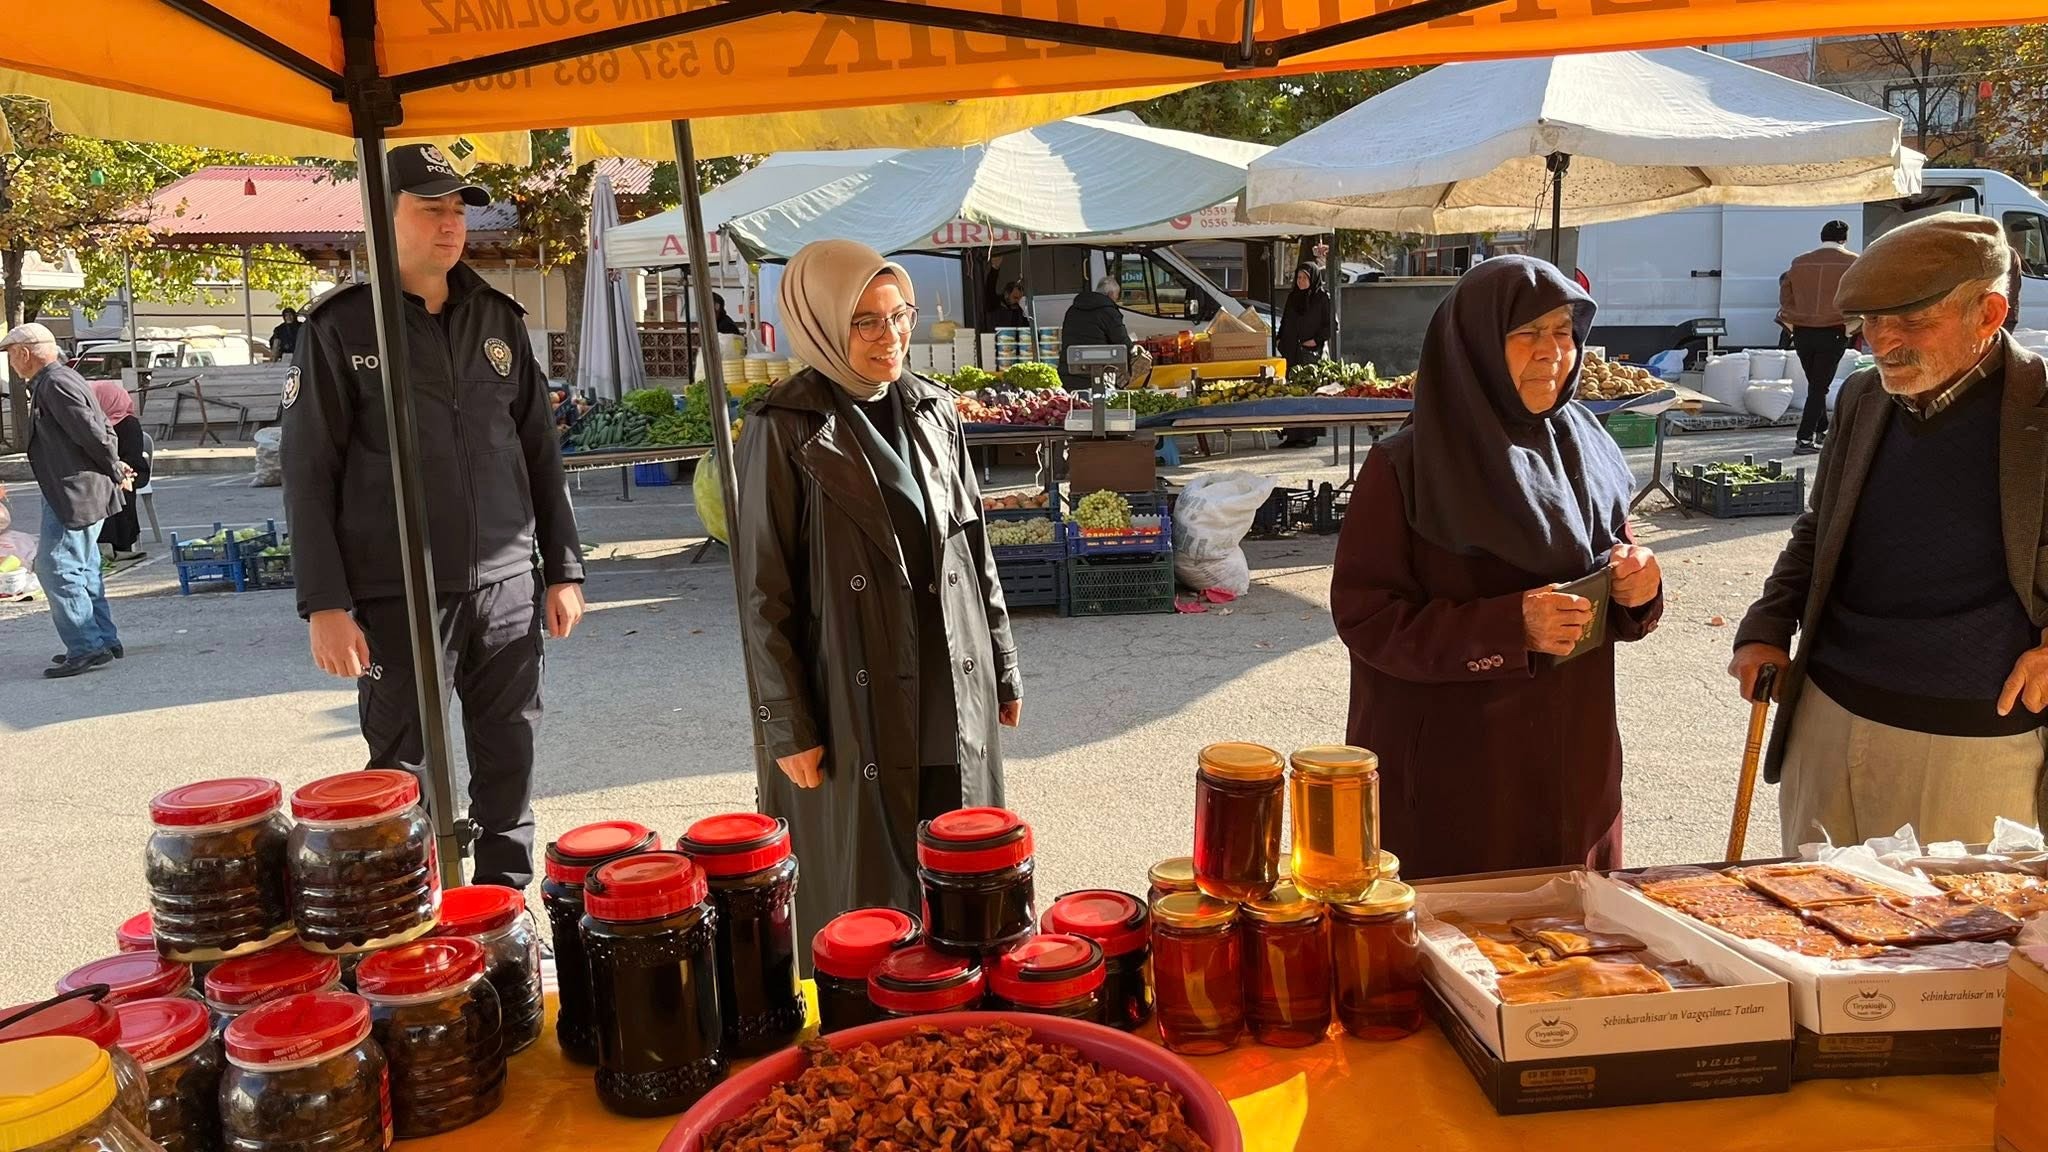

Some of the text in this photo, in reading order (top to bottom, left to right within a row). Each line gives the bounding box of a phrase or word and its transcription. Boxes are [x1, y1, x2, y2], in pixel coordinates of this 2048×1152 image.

[1602, 1003, 1764, 1028] Şebinkarahisar'ın Vazgeçilmez Tatları
